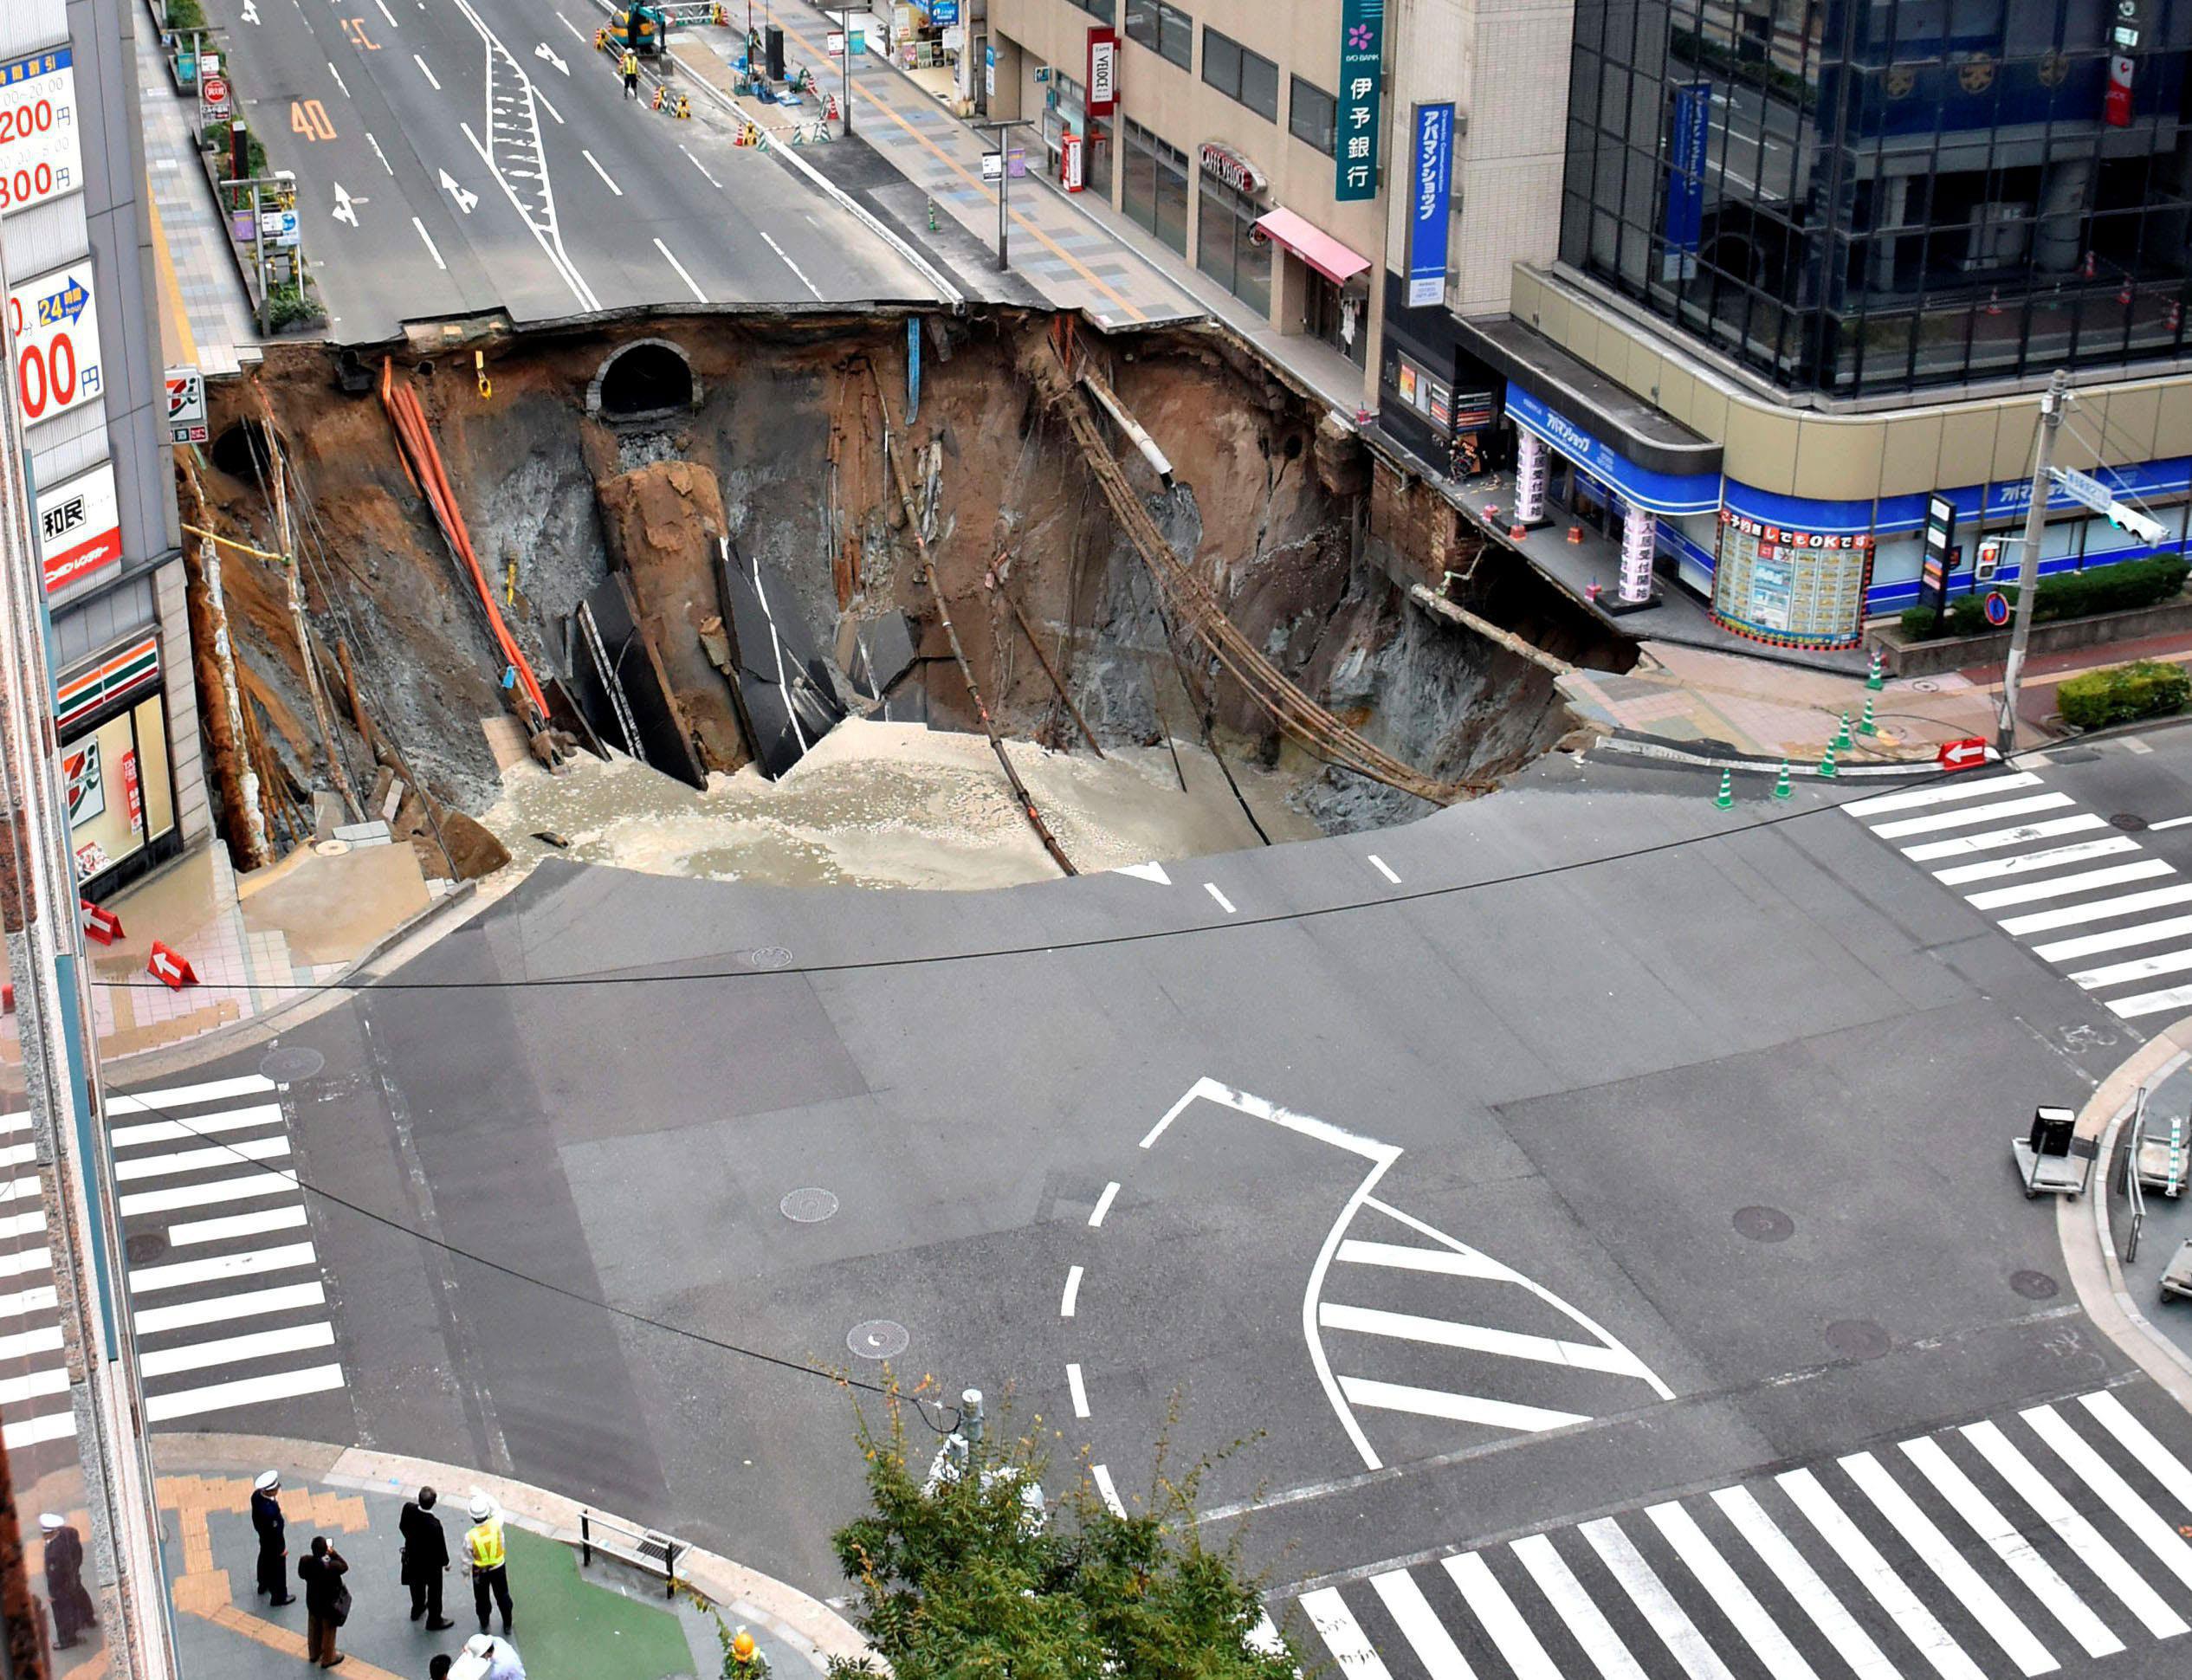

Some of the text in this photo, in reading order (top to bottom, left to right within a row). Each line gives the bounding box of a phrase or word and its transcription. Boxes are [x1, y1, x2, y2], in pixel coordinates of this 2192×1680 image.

[1096, 55, 1109, 88] VELOCE
[291, 100, 337, 141] 40
[1347, 77, 1373, 188] 伊予銀行
[1222, 158, 1246, 191] VELOCE
[1419, 110, 1439, 221] アパマンショップ
[39, 295, 63, 326] 24
[66, 304, 83, 315] hour
[43, 498, 84, 538] 和民
